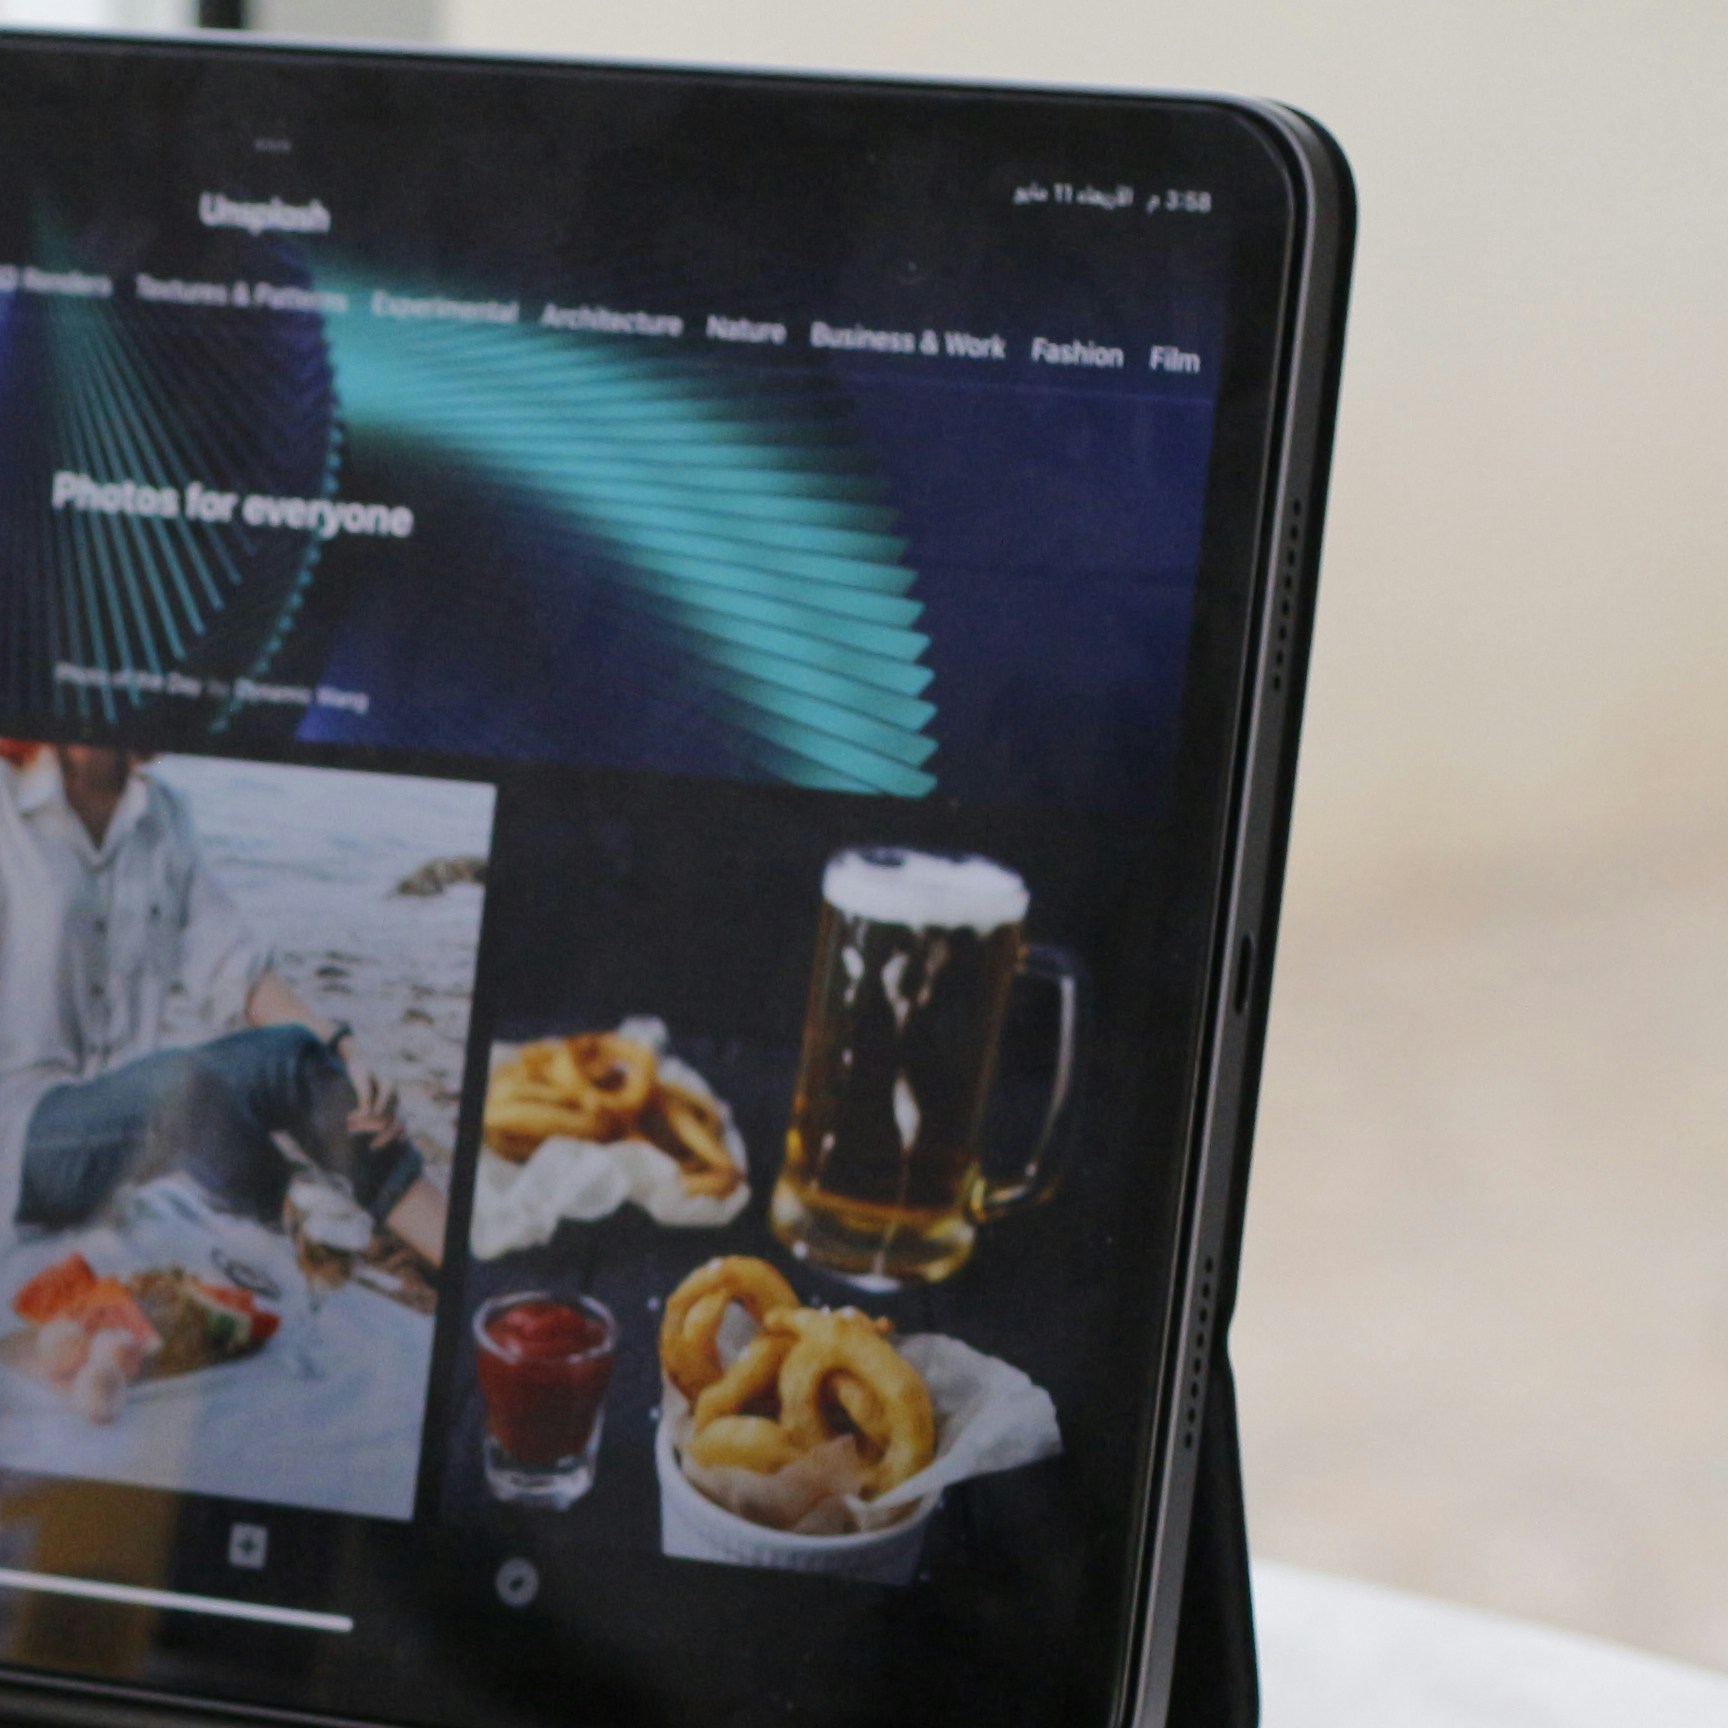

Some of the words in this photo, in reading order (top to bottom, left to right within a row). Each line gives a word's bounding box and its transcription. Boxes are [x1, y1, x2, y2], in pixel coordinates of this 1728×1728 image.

[199, 192, 331, 234] Unsplash
[136, 272, 228, 306] Textures
[254, 280, 348, 313] Patterns
[371, 289, 520, 325] Experimental
[540, 302, 684, 337] Architecture
[706, 313, 787, 345] Nature
[809, 320, 916, 354] Business
[918, 328, 939, 356] &
[944, 330, 1006, 360] Work
[1031, 336, 1124, 369] Fashion
[1149, 344, 1201, 374] Film
[52, 470, 179, 519] Photos
[185, 481, 239, 523] for
[243, 492, 414, 539] everyone
